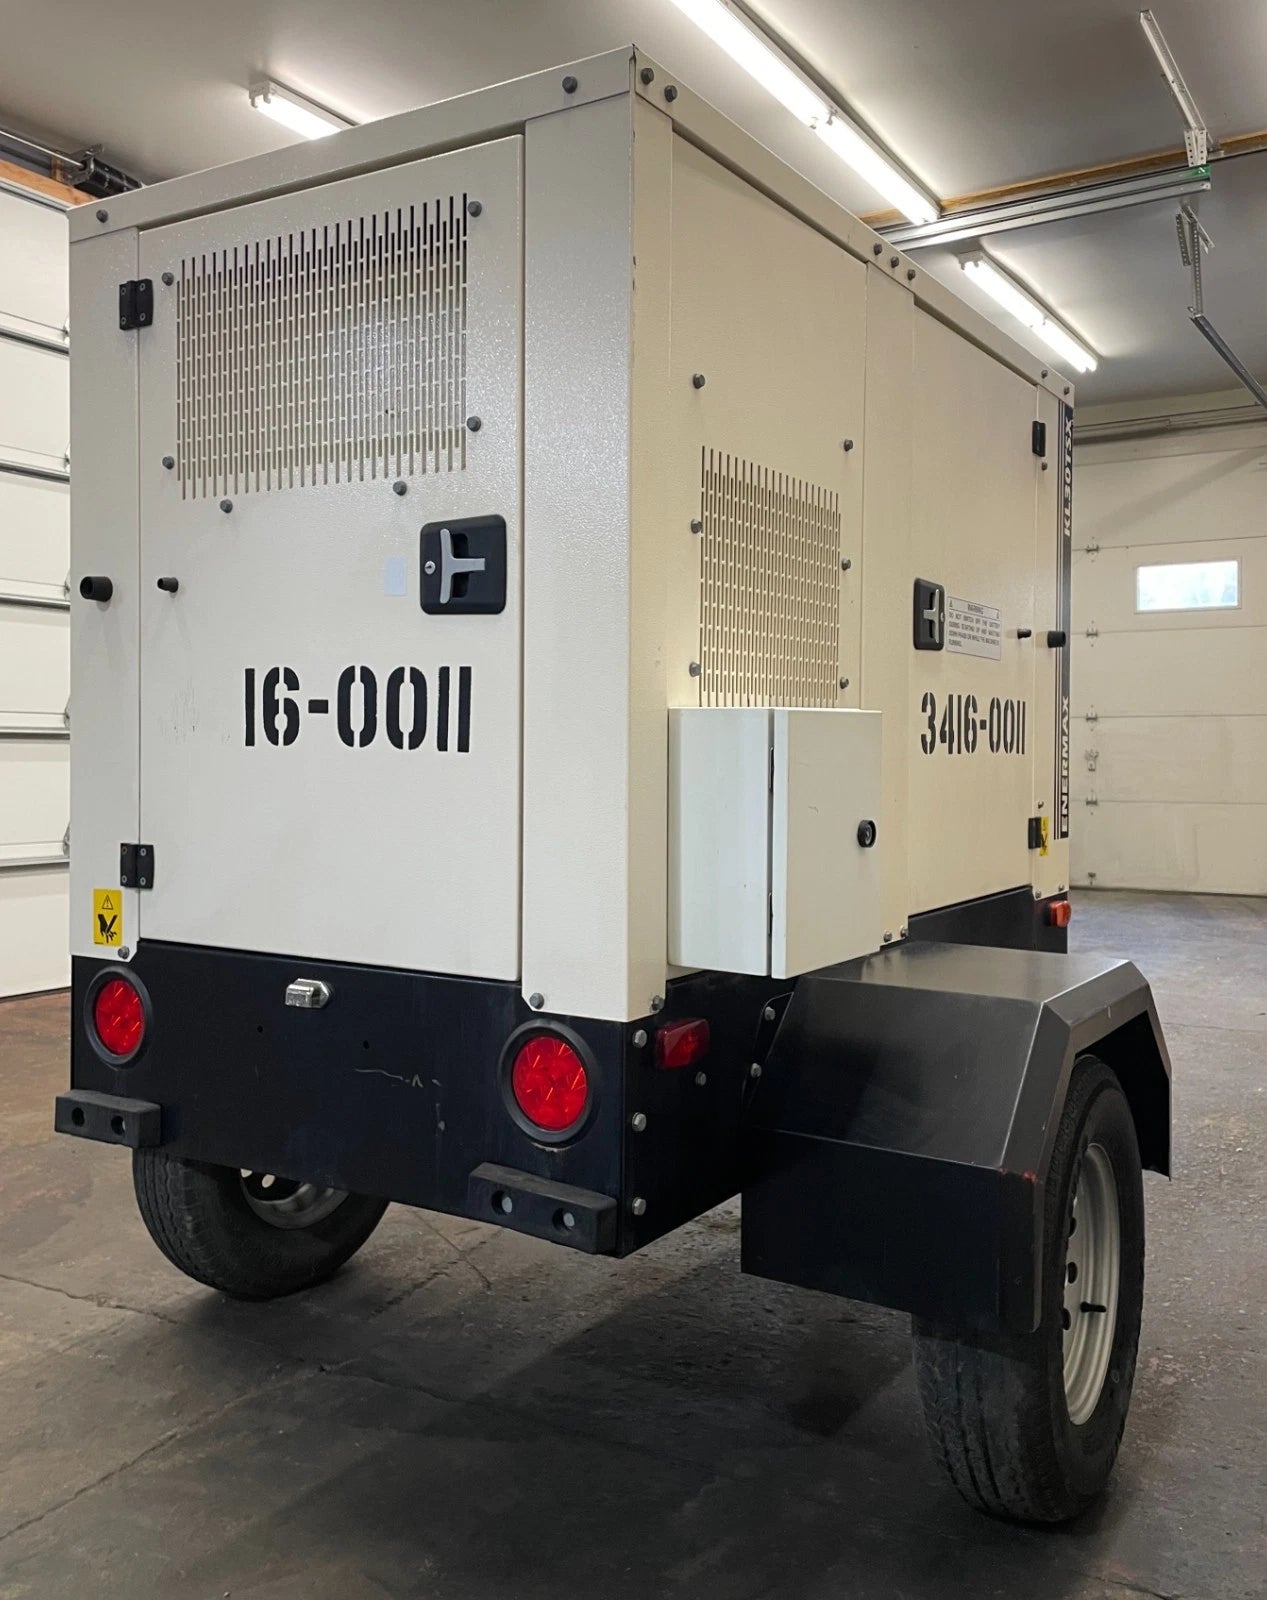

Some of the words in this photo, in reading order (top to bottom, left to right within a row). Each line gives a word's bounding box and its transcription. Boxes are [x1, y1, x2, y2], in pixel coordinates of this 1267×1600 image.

[245, 665, 472, 753] 16-0011
[921, 691, 1026, 755] 3416-0011
[1061, 696, 1069, 832] ENERMAX
